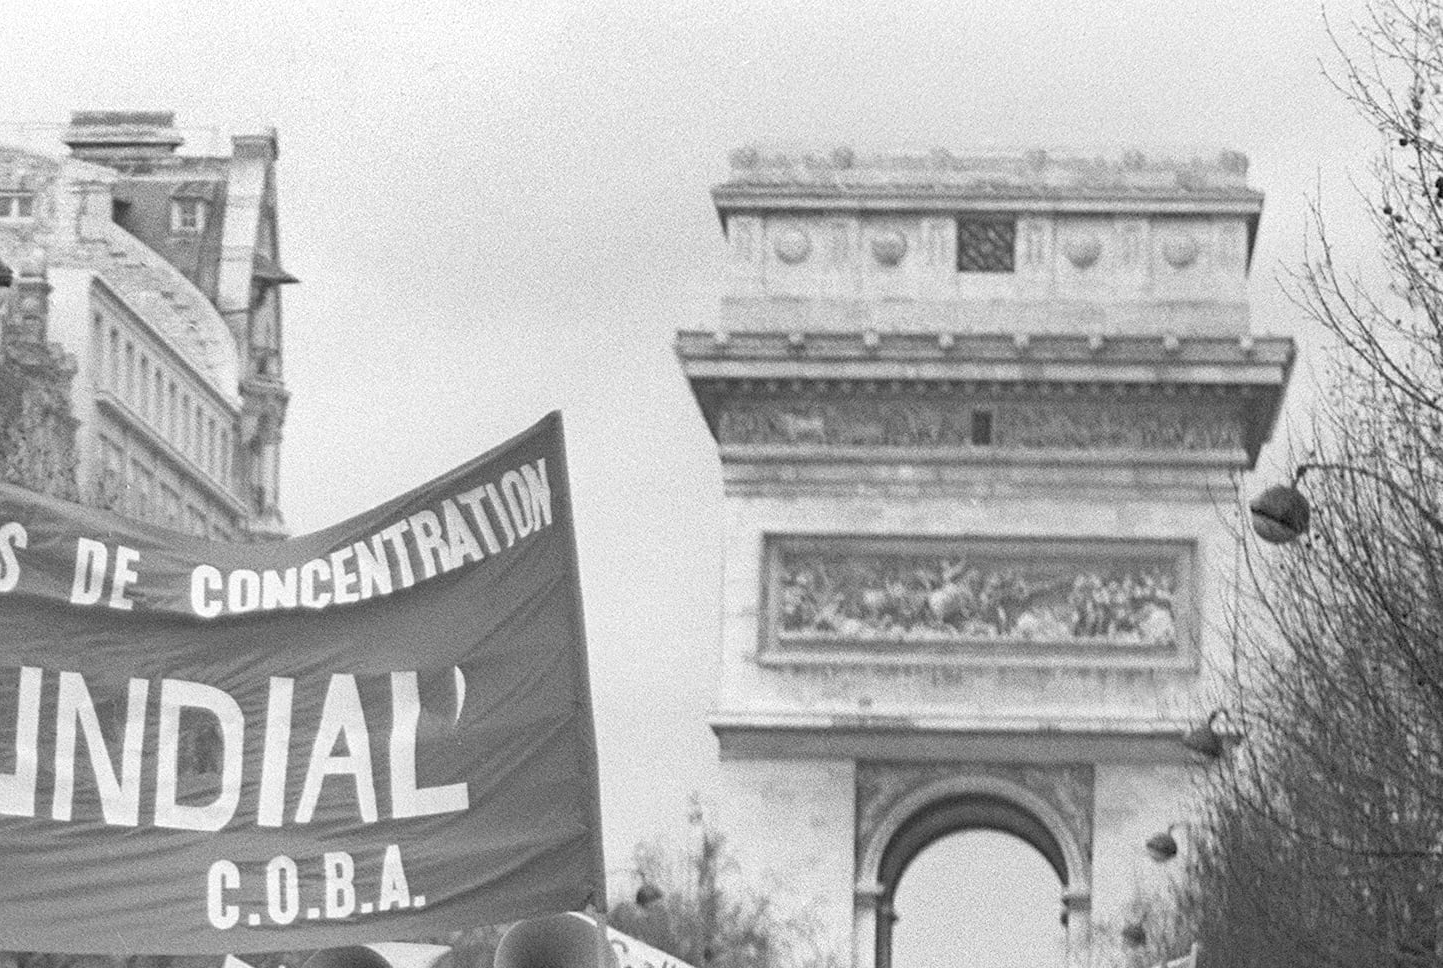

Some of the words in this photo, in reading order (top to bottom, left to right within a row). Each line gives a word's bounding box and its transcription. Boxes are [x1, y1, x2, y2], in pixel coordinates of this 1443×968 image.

[71, 537, 142, 611] DE
[191, 457, 555, 618] CONCENTRATION
[205, 844, 427, 931] C.O.B.A.
